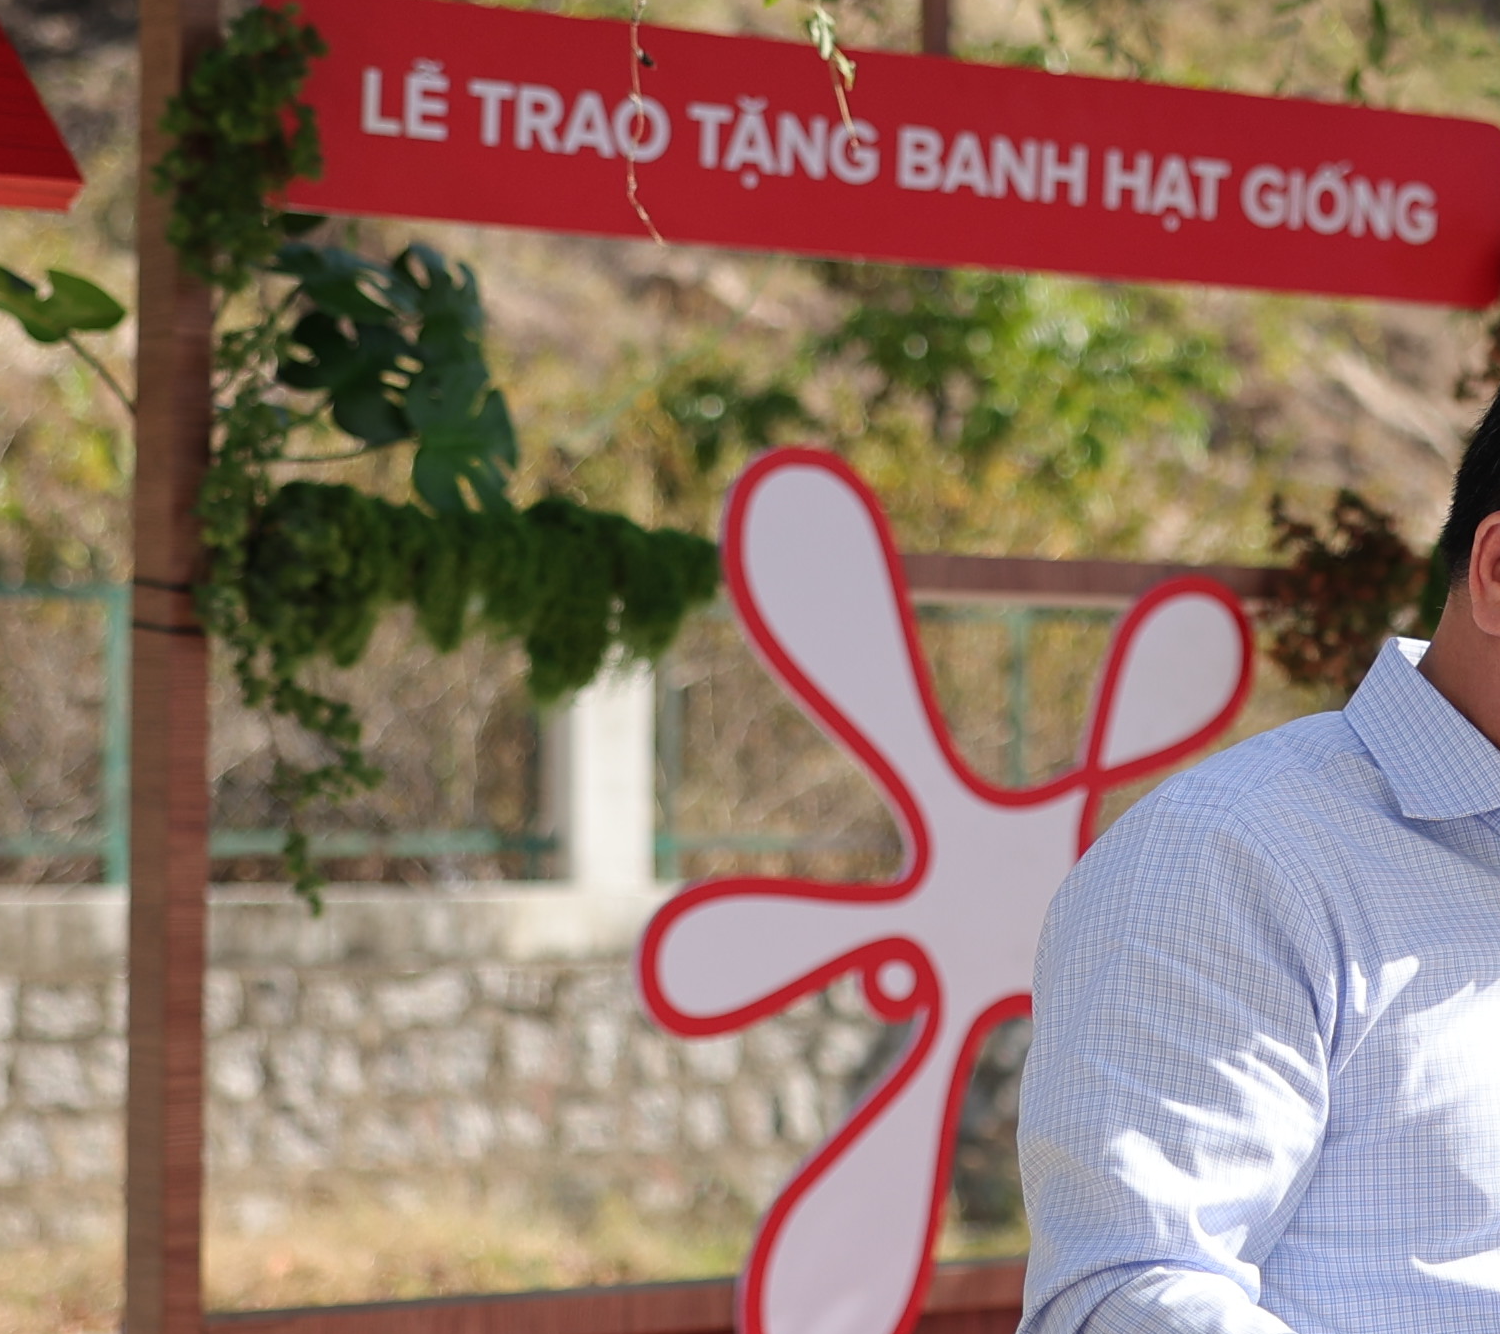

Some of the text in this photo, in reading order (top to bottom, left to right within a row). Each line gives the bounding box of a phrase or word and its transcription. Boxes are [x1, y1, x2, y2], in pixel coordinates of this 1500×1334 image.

[360, 60, 1438, 244] LỄ TRAO TẶNG BANH HẠT GIỐNG
